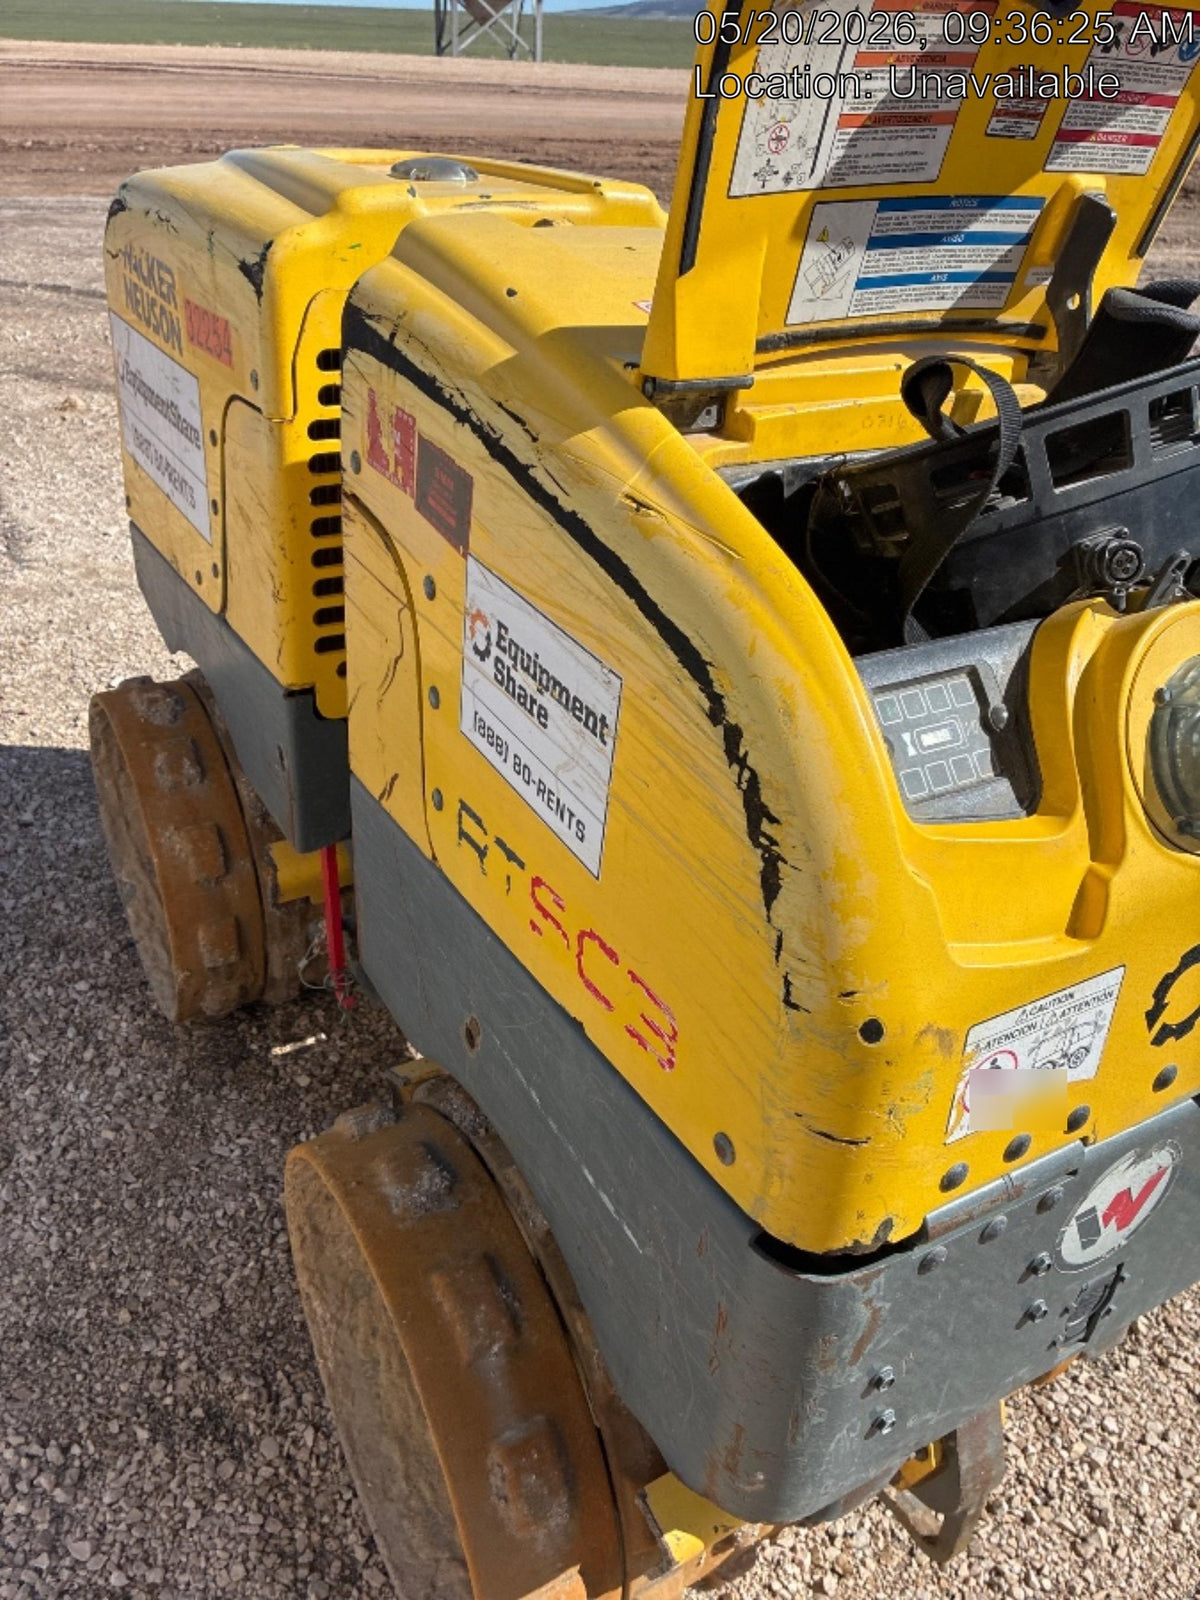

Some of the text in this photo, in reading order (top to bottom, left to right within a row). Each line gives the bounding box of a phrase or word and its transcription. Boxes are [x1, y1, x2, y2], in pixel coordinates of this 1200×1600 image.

[123, 272, 184, 358] NEUSON
[493, 655, 549, 731] Share
[495, 619, 609, 746] Equipment
[473, 709, 586, 844] (888) 80-RENTS
[1029, 992, 1075, 1016] CAUTION
[1060, 988, 1114, 1019] ATTENTION
